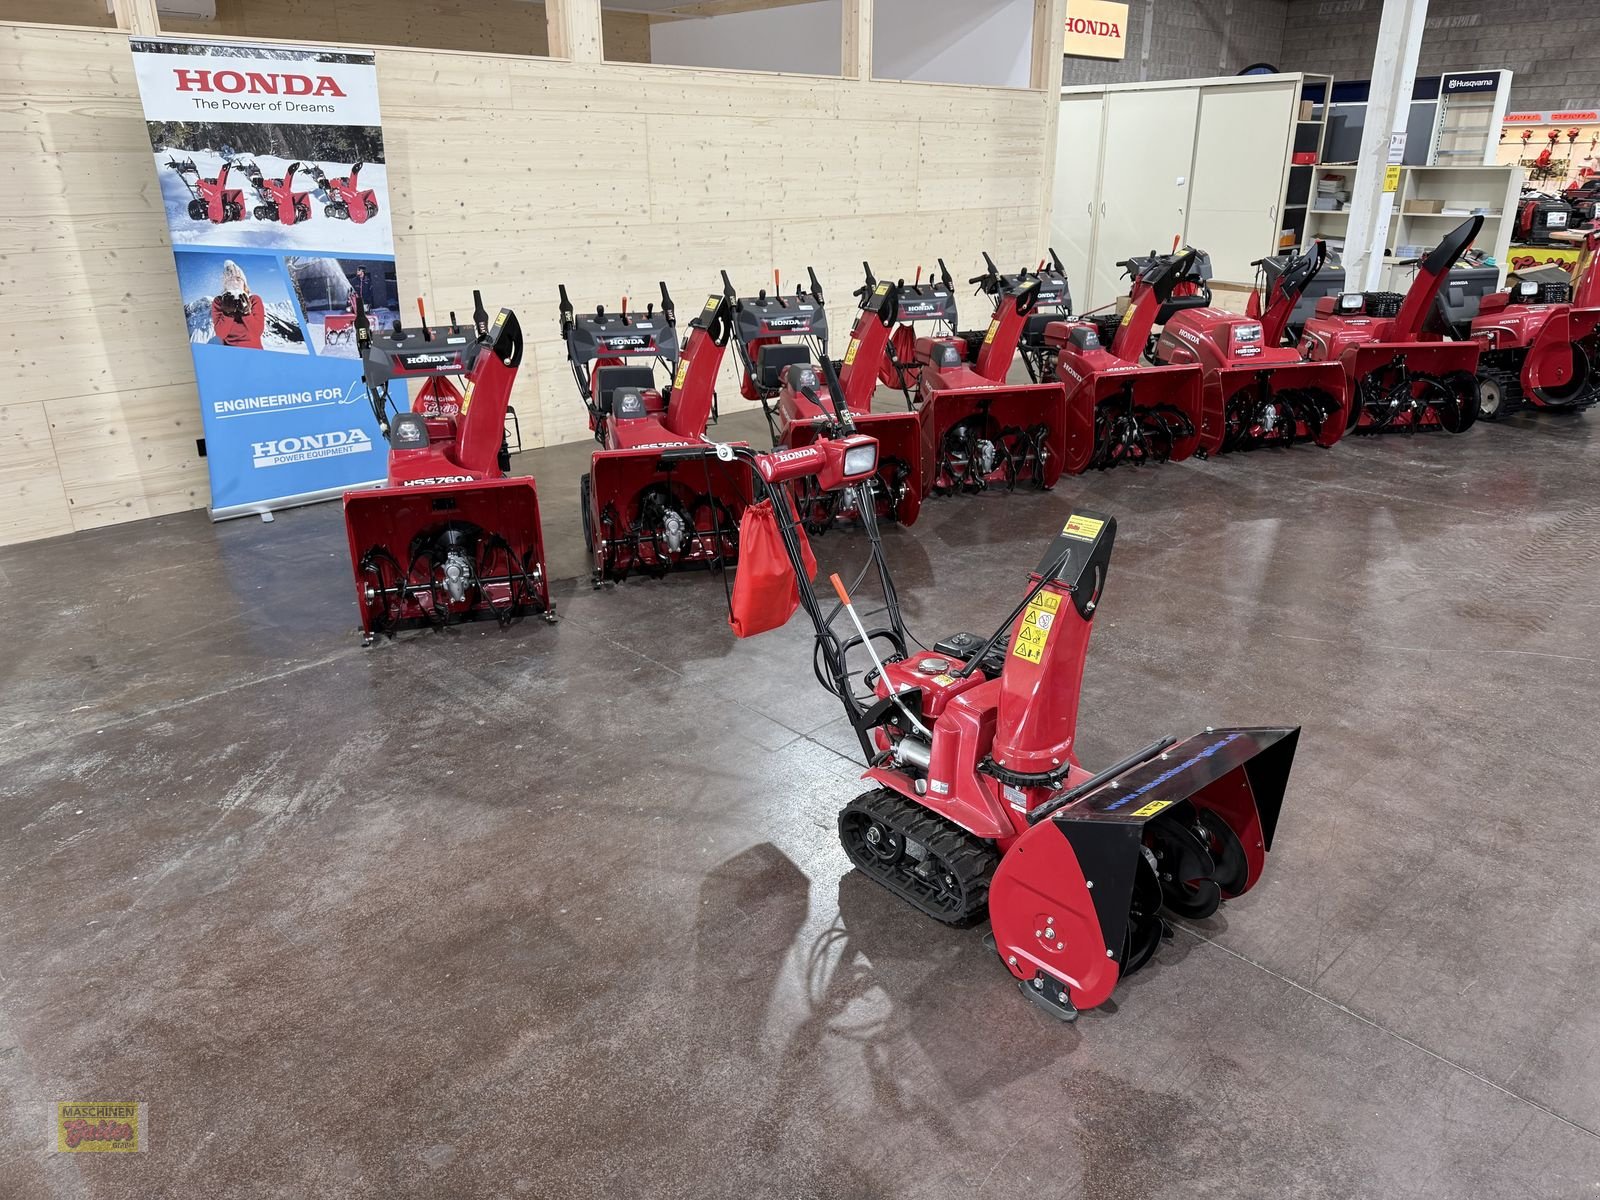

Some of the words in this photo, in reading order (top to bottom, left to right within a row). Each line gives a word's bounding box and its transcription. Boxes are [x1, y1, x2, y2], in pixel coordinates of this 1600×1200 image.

[1065, 17, 1121, 38] HONDA
[173, 69, 347, 97] HONDA
[1456, 79, 1493, 88] Husqvarna
[192, 98, 219, 109] The
[222, 99, 266, 111] Power
[269, 101, 282, 111] of
[285, 101, 335, 113] Dreams
[908, 304, 935, 312] HONDA
[610, 338, 645, 346] HONDA
[1179, 328, 1200, 345] HONDA
[407, 355, 449, 364] HONDA
[1062, 362, 1082, 382] HOND
[213, 392, 312, 413] ENGINEERING
[316, 387, 343, 400] FOR
[251, 428, 371, 458] HONDA
[273, 453, 305, 464] POWER
[307, 445, 354, 460] EQUIPMENT
[779, 447, 818, 462] HONDA
[404, 475, 475, 487] HSS760A
